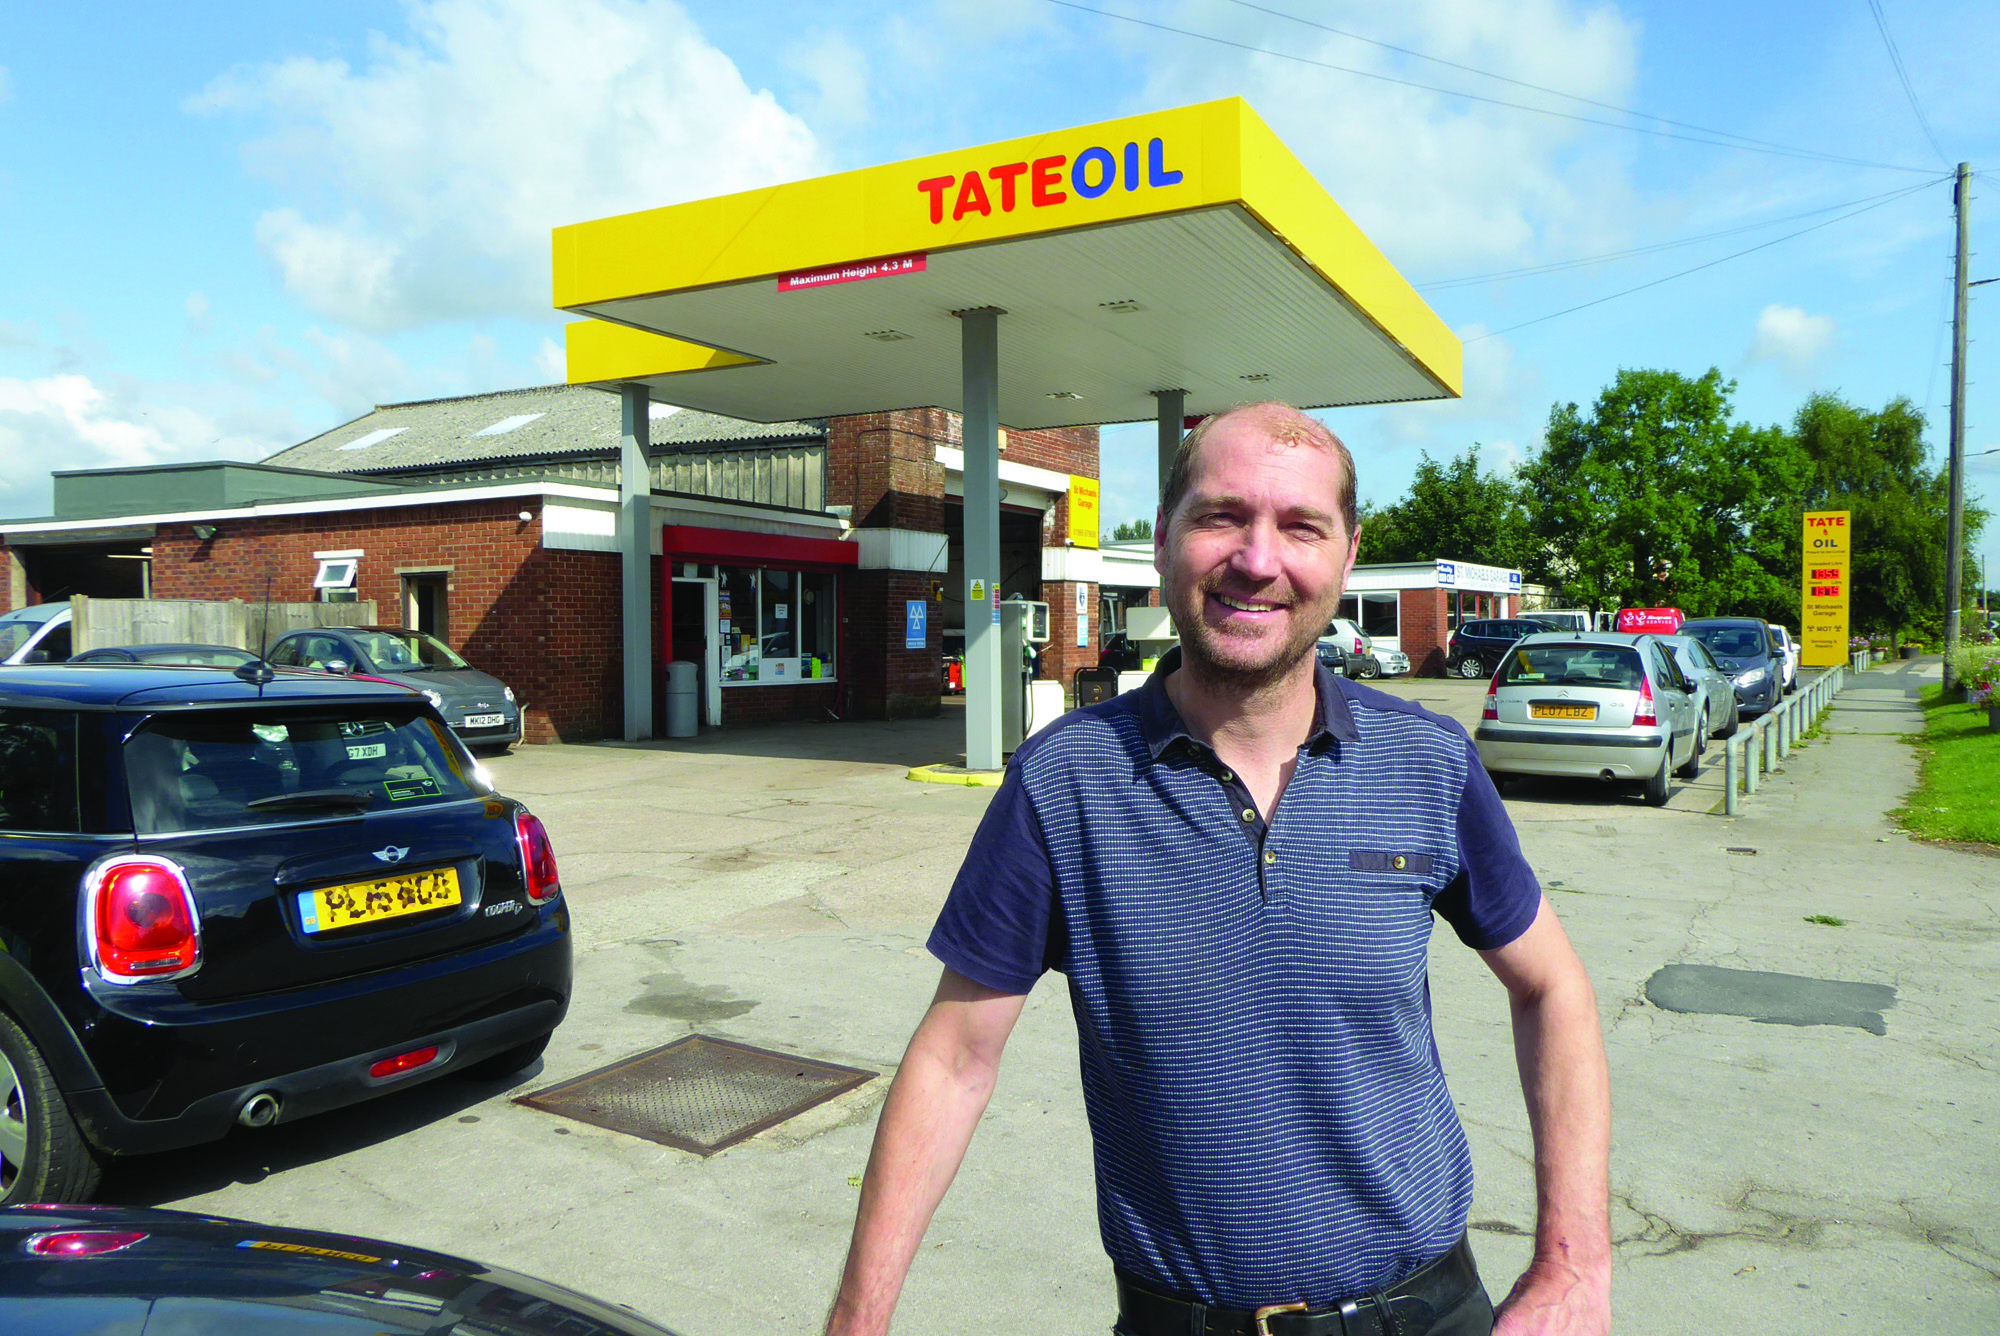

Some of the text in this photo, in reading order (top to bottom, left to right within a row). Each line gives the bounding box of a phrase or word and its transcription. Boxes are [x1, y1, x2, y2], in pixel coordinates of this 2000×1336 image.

[789, 259, 913, 287] Maximum Height 4.3 M
[1078, 498, 1093, 509] Garage
[1807, 517, 1845, 527] TATE
[1813, 539, 1838, 548] OIL
[1465, 566, 1489, 581] MICHAELS
[1534, 705, 1588, 717] PL07 LBZ
